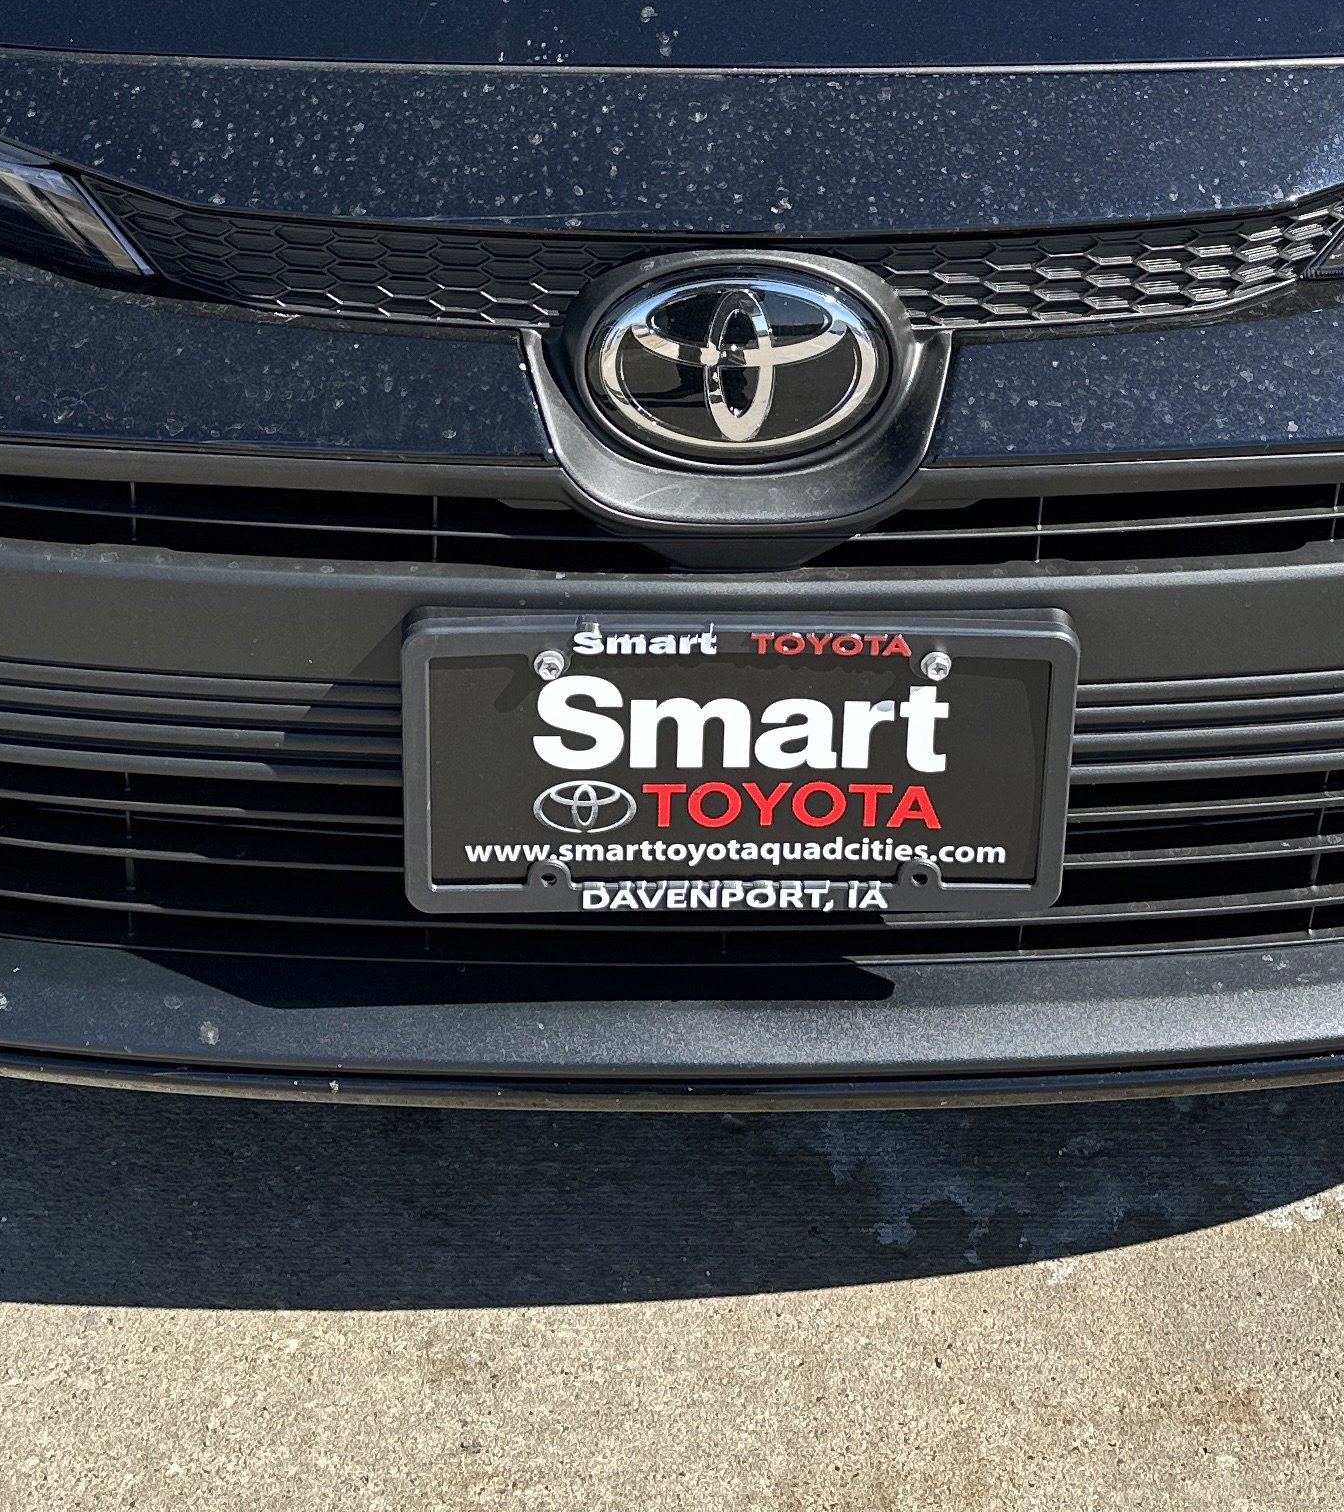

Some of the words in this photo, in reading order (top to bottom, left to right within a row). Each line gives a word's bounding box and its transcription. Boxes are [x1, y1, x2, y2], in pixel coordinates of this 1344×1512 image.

[573, 624, 717, 655] Smart
[751, 631, 913, 657] TOYOTA
[532, 675, 950, 773] Smart
[643, 781, 942, 829] TOYOTA
[465, 837, 1006, 868] www.smarttoyotaquadcities.com
[582, 883, 834, 912] DAVENPORT,
[848, 883, 888, 909] IA
